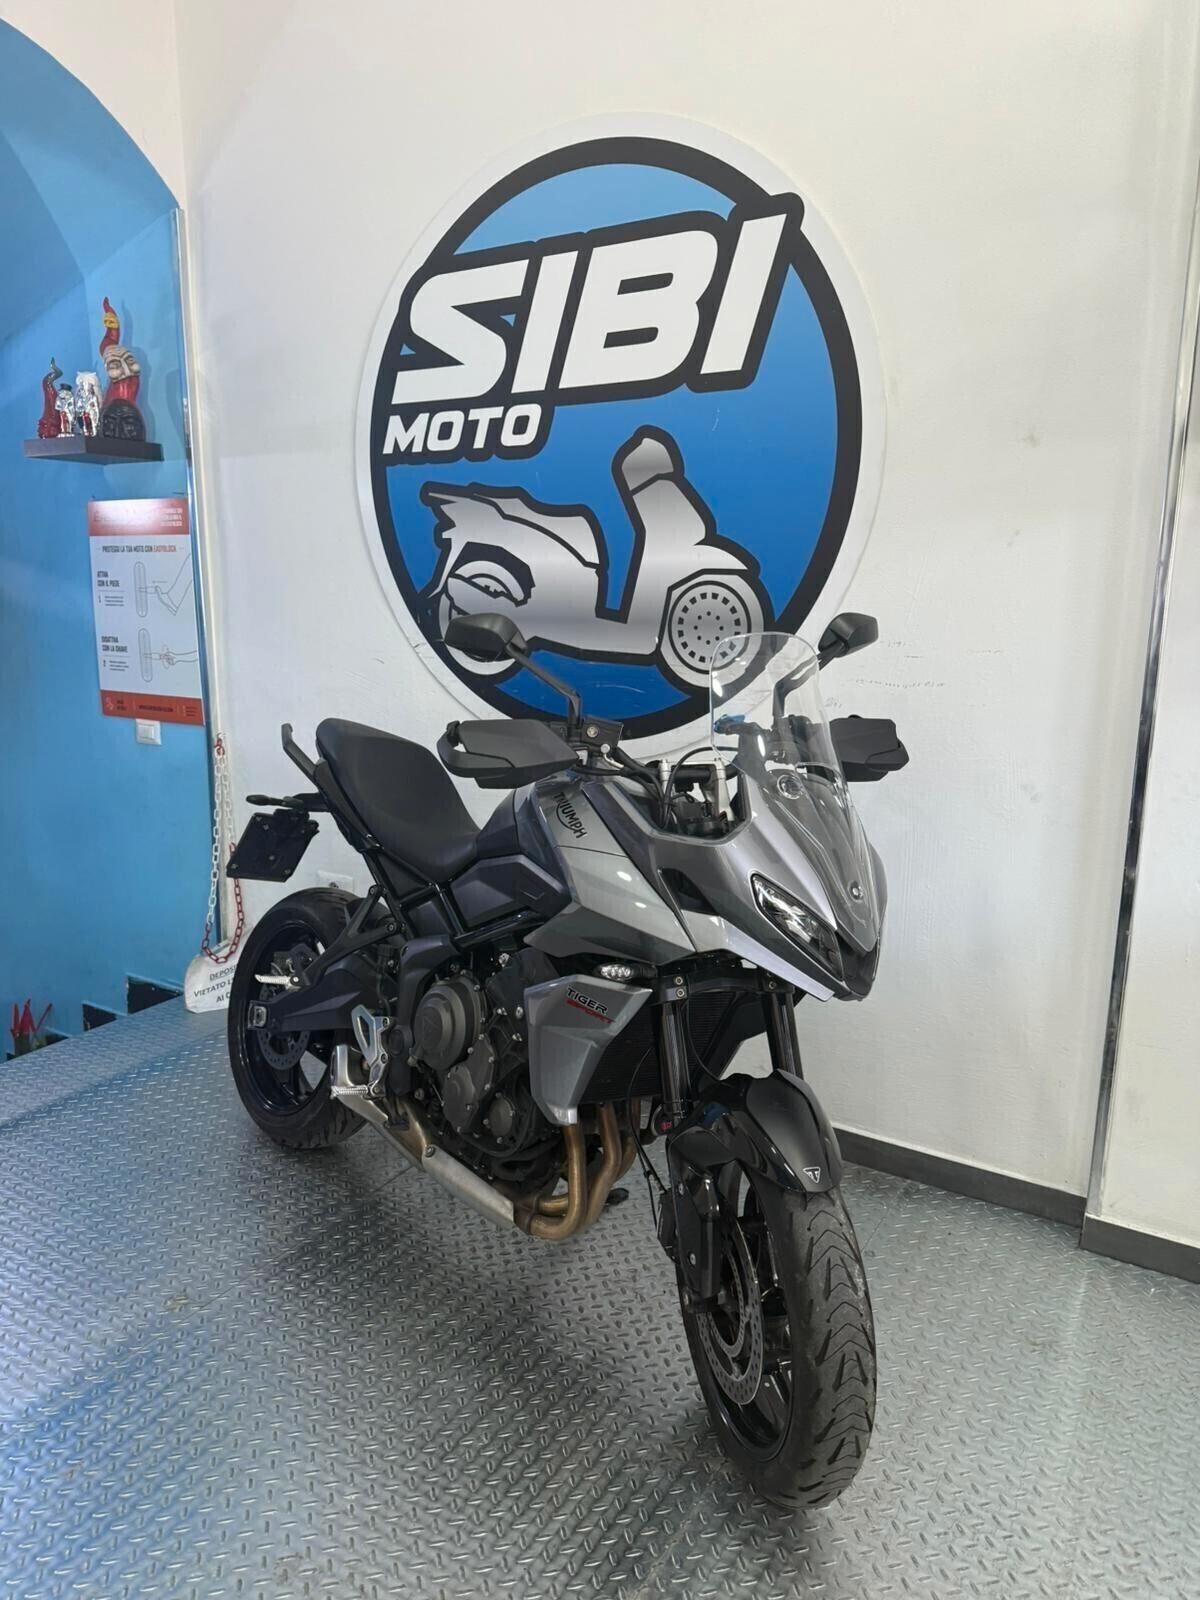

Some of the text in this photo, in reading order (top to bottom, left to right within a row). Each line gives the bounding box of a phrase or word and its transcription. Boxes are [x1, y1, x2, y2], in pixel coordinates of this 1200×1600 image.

[391, 213, 788, 406] SIBI
[382, 403, 542, 456] MOTO
[133, 545, 144, 553] MOTO
[144, 545, 153, 553] CON
[553, 791, 588, 839] TRIUMPH
[209, 965, 237, 981] DEPOSI
[193, 981, 226, 998] VIETATO
[567, 987, 609, 1015] TIGER
